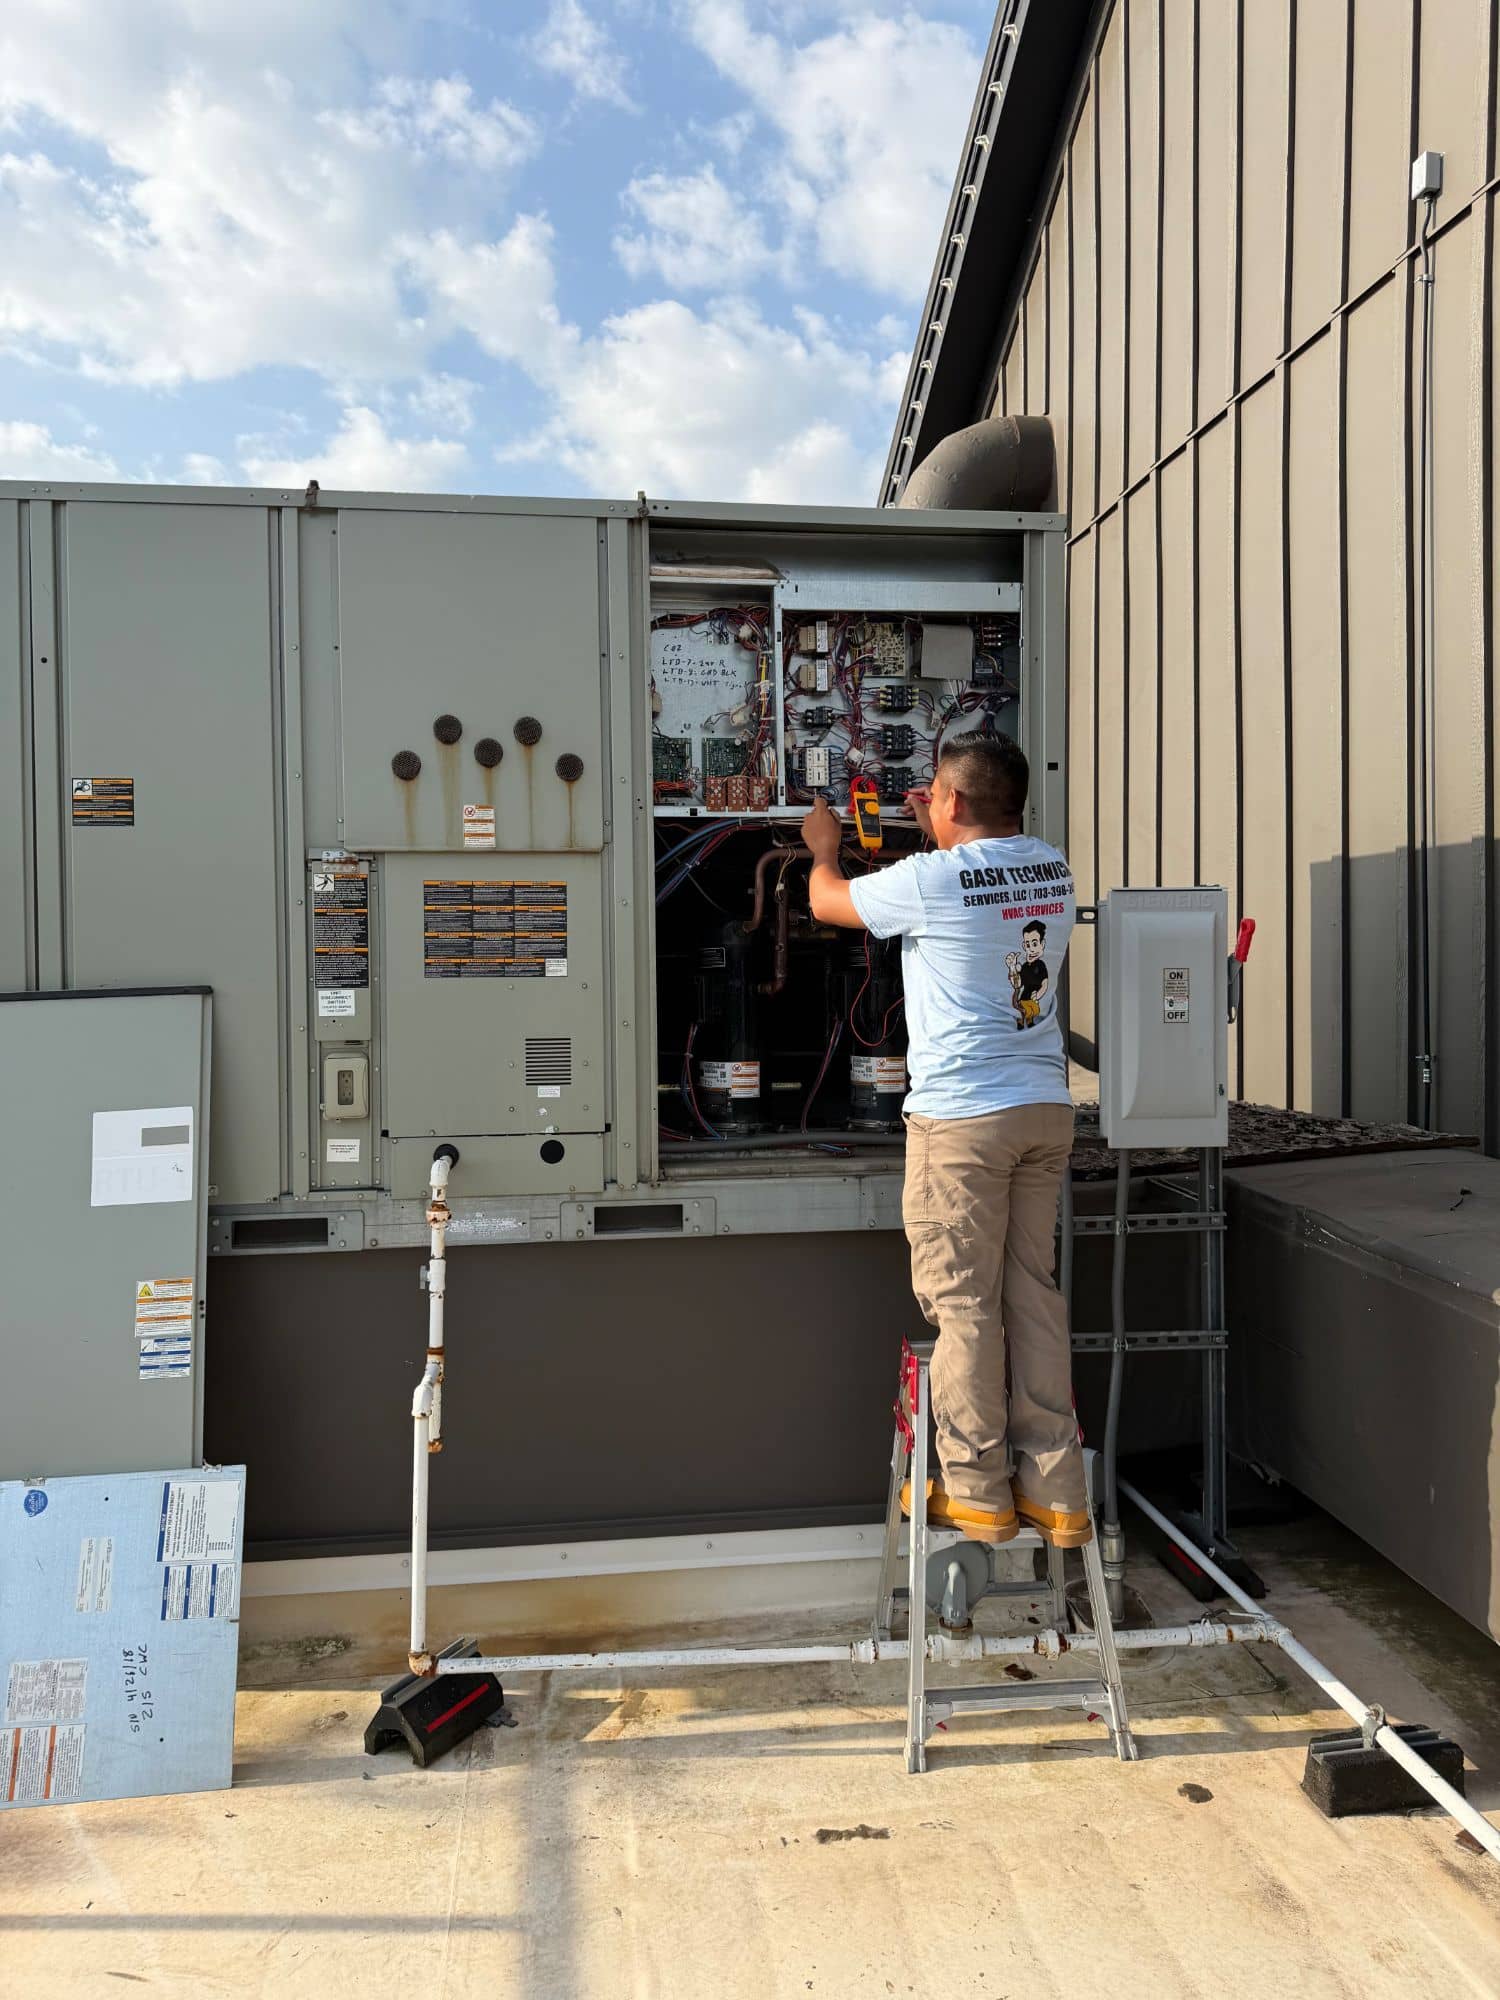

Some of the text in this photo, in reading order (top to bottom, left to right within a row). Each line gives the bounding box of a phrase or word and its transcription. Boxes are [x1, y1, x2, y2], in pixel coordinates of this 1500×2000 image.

[959, 867, 1009, 890] GASK
[1013, 889, 1027, 902] LLC
[1001, 902, 1065, 921] HVAC SERVICES
[1169, 971, 1183, 980] ON
[1167, 1011, 1186, 1020] OFF
